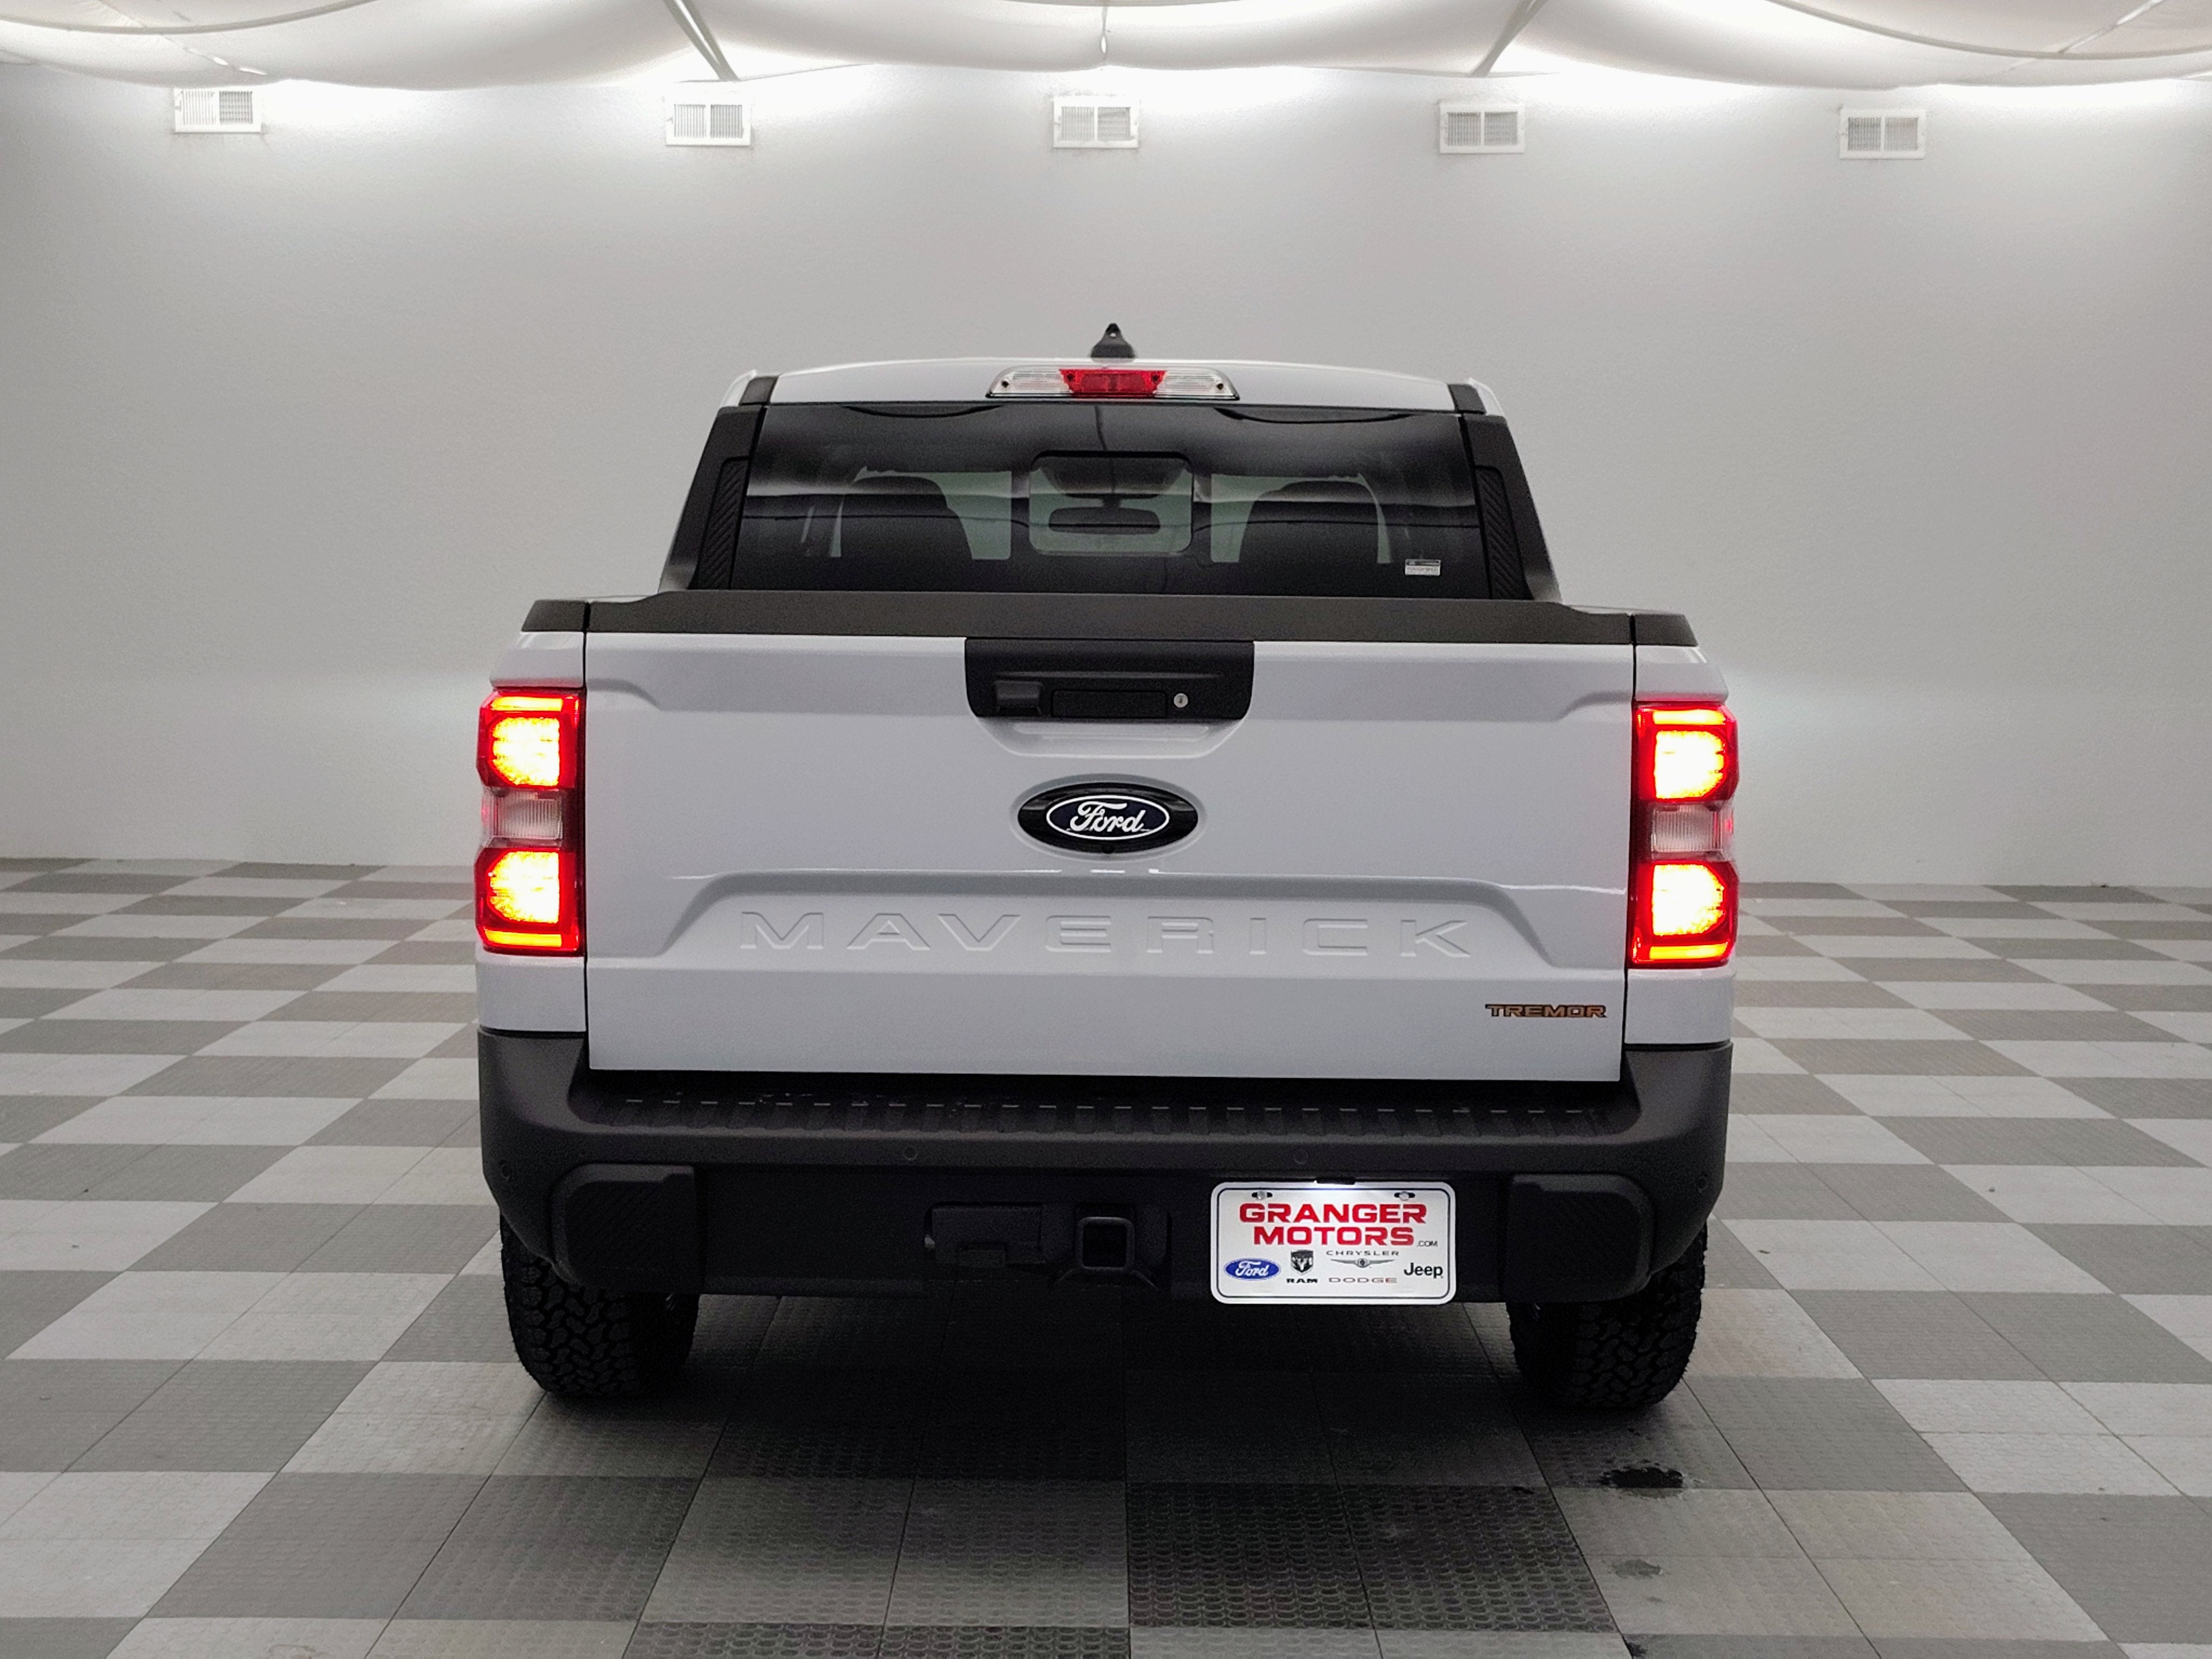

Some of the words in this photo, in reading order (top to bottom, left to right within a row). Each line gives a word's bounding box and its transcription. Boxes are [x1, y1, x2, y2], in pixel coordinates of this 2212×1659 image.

[1069, 801, 1147, 832] Ford
[740, 912, 1471, 957] MAVERICK
[1485, 1004, 1607, 1017] TREMOR
[1239, 1203, 1427, 1223] GRANGER
[1253, 1226, 1414, 1245] MOTORS
[1235, 1260, 1269, 1276] Ford
[1404, 1263, 1443, 1278] Jeep
